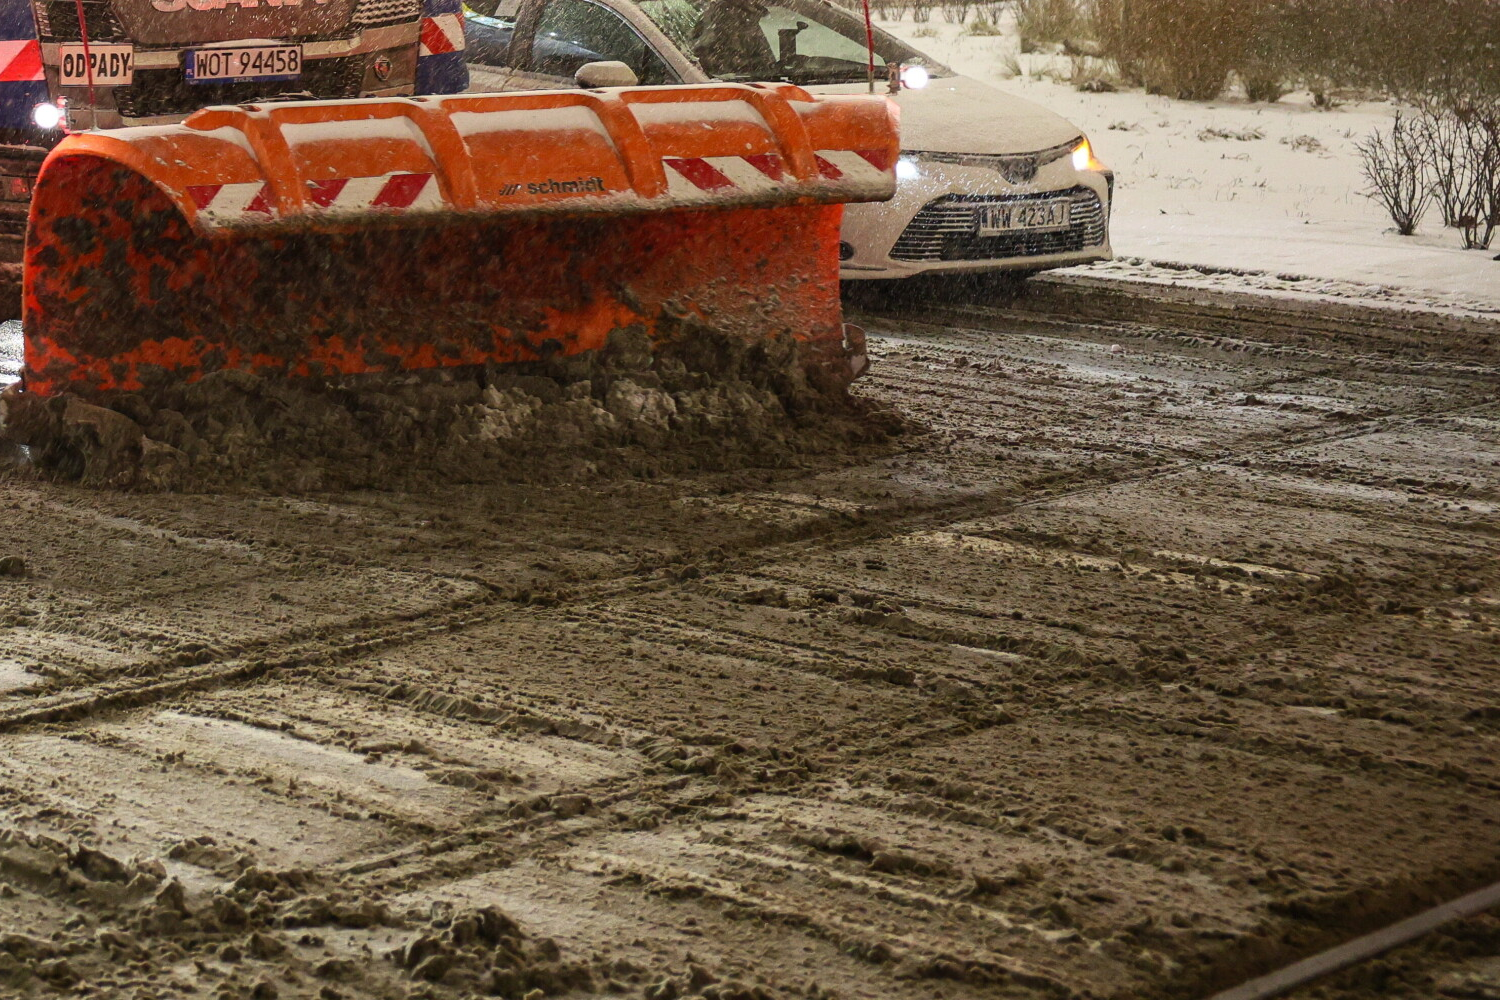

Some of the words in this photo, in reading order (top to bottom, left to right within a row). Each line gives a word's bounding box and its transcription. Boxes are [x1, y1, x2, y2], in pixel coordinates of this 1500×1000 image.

[63, 52, 131, 78] ODPADY
[196, 52, 233, 76] WOT
[240, 50, 299, 75] 94458
[527, 176, 605, 195] schmidt
